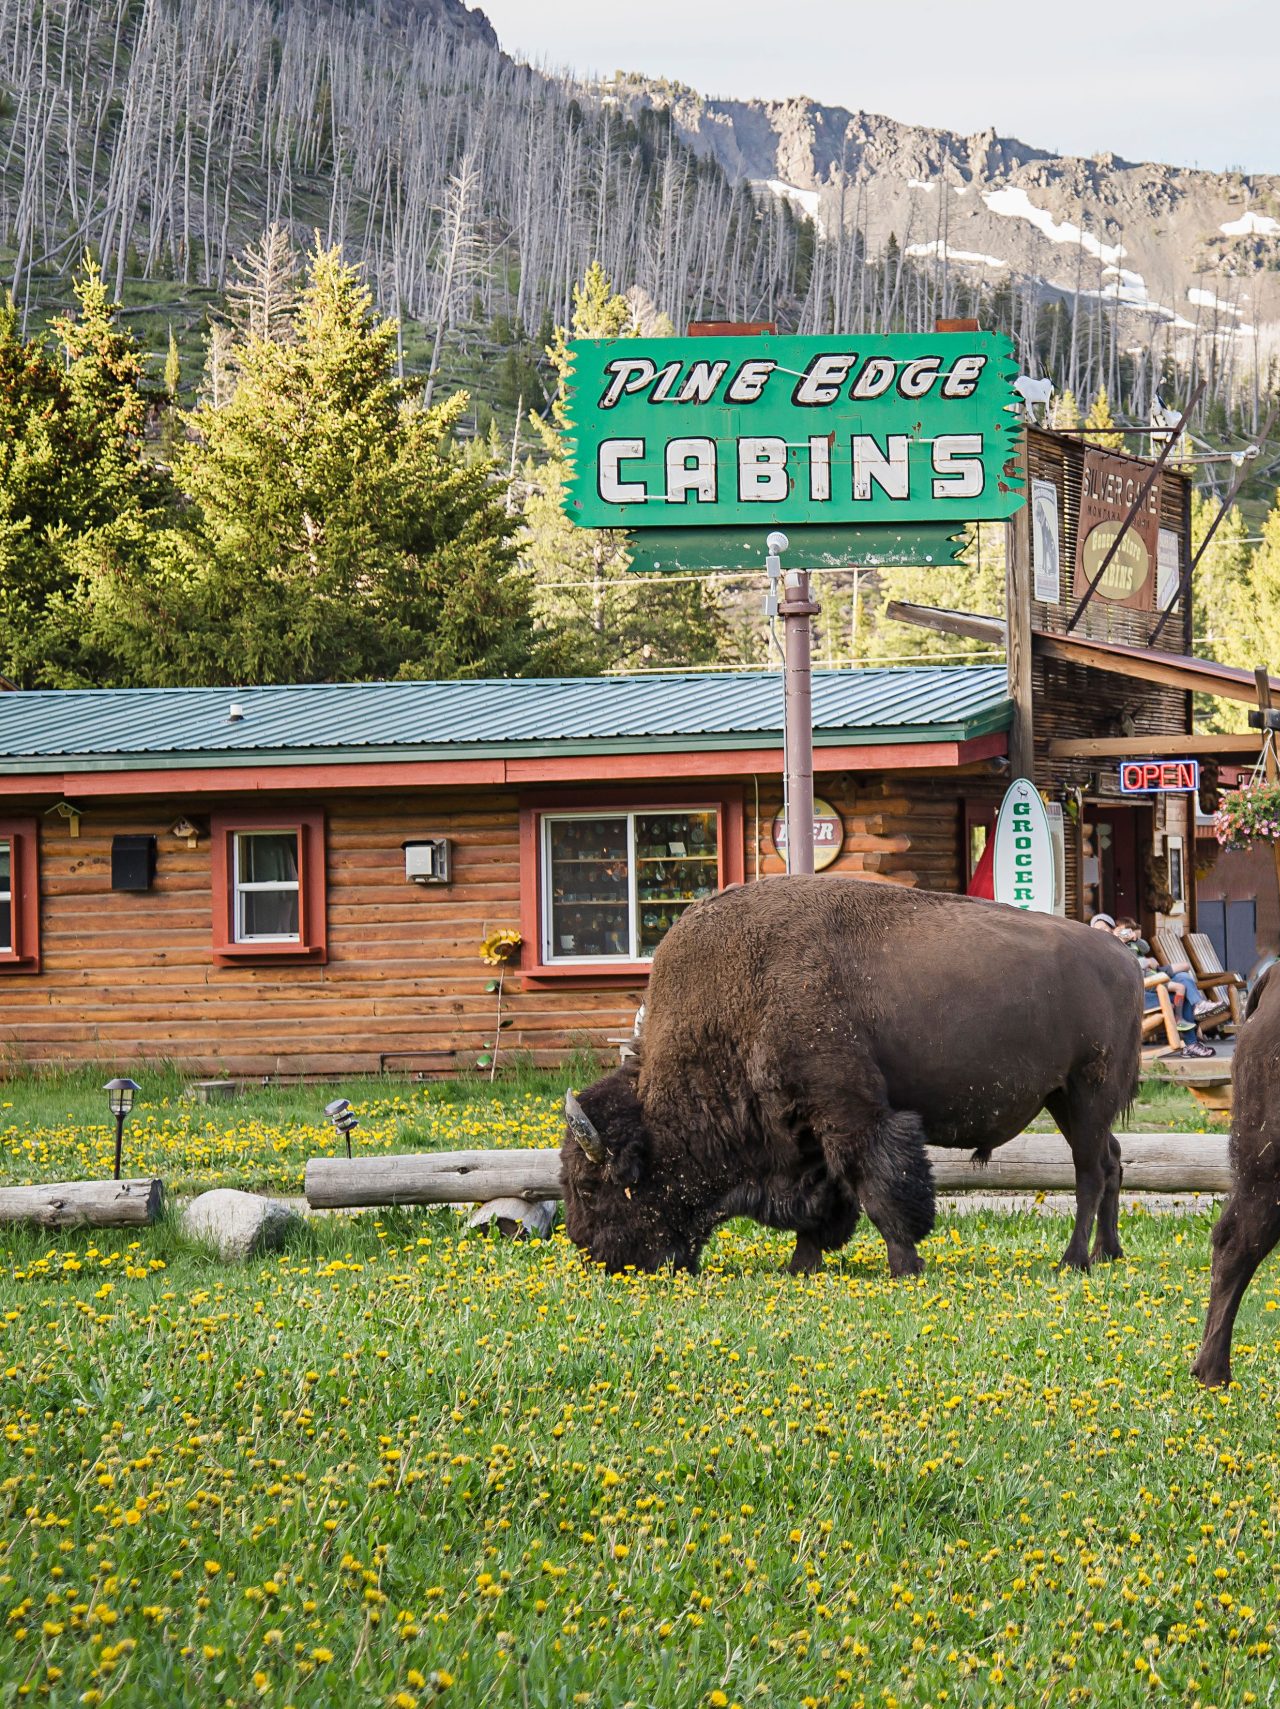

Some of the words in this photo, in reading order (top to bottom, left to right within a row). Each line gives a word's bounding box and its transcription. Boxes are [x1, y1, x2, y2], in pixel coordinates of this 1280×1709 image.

[599, 358, 776, 409] PINE
[792, 353, 988, 406] EDGE
[597, 433, 985, 505] CABINS
[1083, 467, 1123, 506] SILVER
[1087, 505, 1121, 521] MONTANA
[1123, 763, 1195, 790] OPEN
[1012, 802, 1035, 910] GROCER
